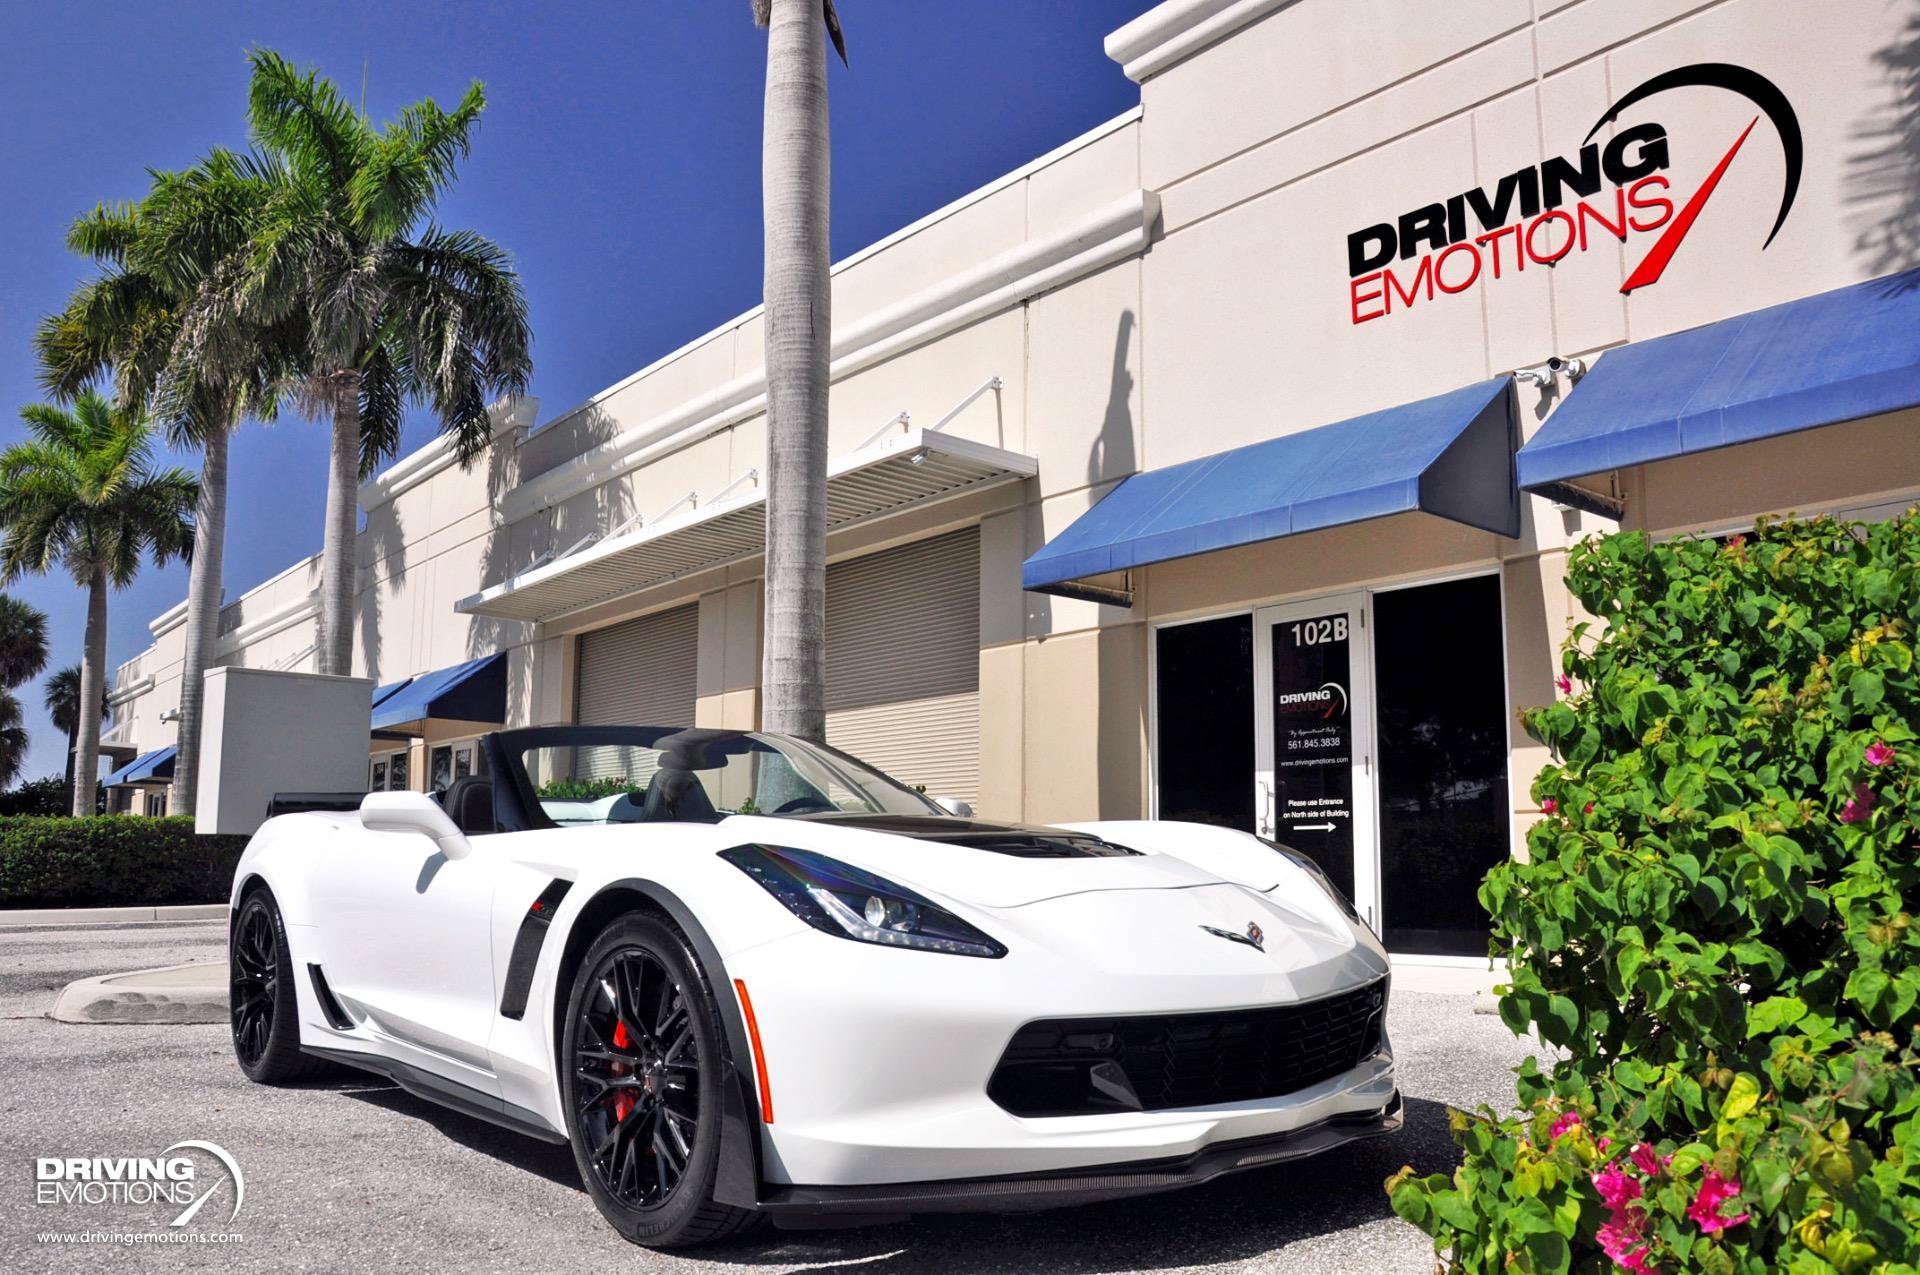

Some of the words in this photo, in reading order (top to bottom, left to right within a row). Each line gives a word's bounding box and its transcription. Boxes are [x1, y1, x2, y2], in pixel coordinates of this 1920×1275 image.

[1347, 122, 1670, 278] DRIVING
[1350, 175, 1674, 325] EMOTIONS
[1291, 617, 1348, 647] 102B
[1280, 690, 1331, 704] DRIVING
[1288, 737, 1341, 750] 561.845.3838
[1280, 757, 1349, 767] www.drivingemotions.com
[1318, 798, 1344, 806] Entrance
[1326, 810, 1350, 818] Building
